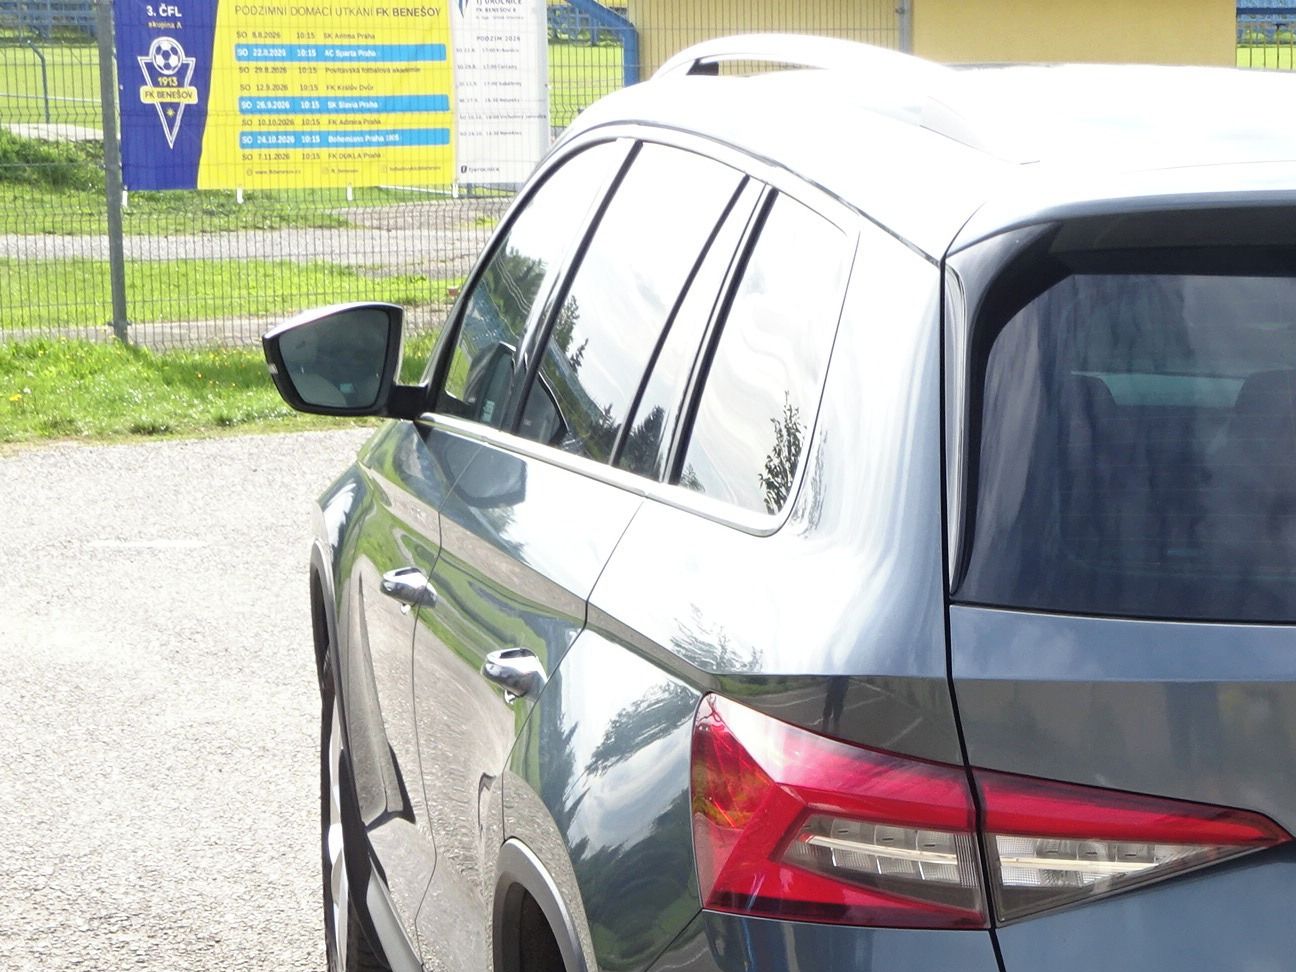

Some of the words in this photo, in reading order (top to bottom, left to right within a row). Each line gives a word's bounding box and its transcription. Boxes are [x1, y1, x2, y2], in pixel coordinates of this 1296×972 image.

[146, 5, 157, 17] 3.
[159, 3, 183, 17] ČFL
[376, 7, 389, 17] FK
[392, 6, 441, 17] BENEŠOV
[176, 21, 183, 30] A
[236, 31, 248, 39] SO
[296, 31, 315, 39] 10:15
[236, 48, 248, 57] SO
[297, 48, 317, 57] 10:15
[324, 49, 335, 57] AC
[335, 49, 357, 58] Sparta
[357, 49, 377, 57] Praha
[238, 66, 250, 74] SO
[298, 66, 318, 74] 10:15
[158, 76, 178, 87] 1913
[240, 84, 251, 92] SO
[299, 84, 319, 92] 10:15
[326, 84, 336, 92] FK
[145, 91, 155, 99] FK
[156, 88, 193, 99] BENEŠOV
[241, 101, 253, 109] SO
[300, 101, 320, 109] 10:15
[241, 118, 253, 126] SO
[301, 118, 320, 126] 10:15
[241, 135, 253, 144] SO
[301, 135, 320, 143] 10:15
[301, 152, 320, 160] 10:15
